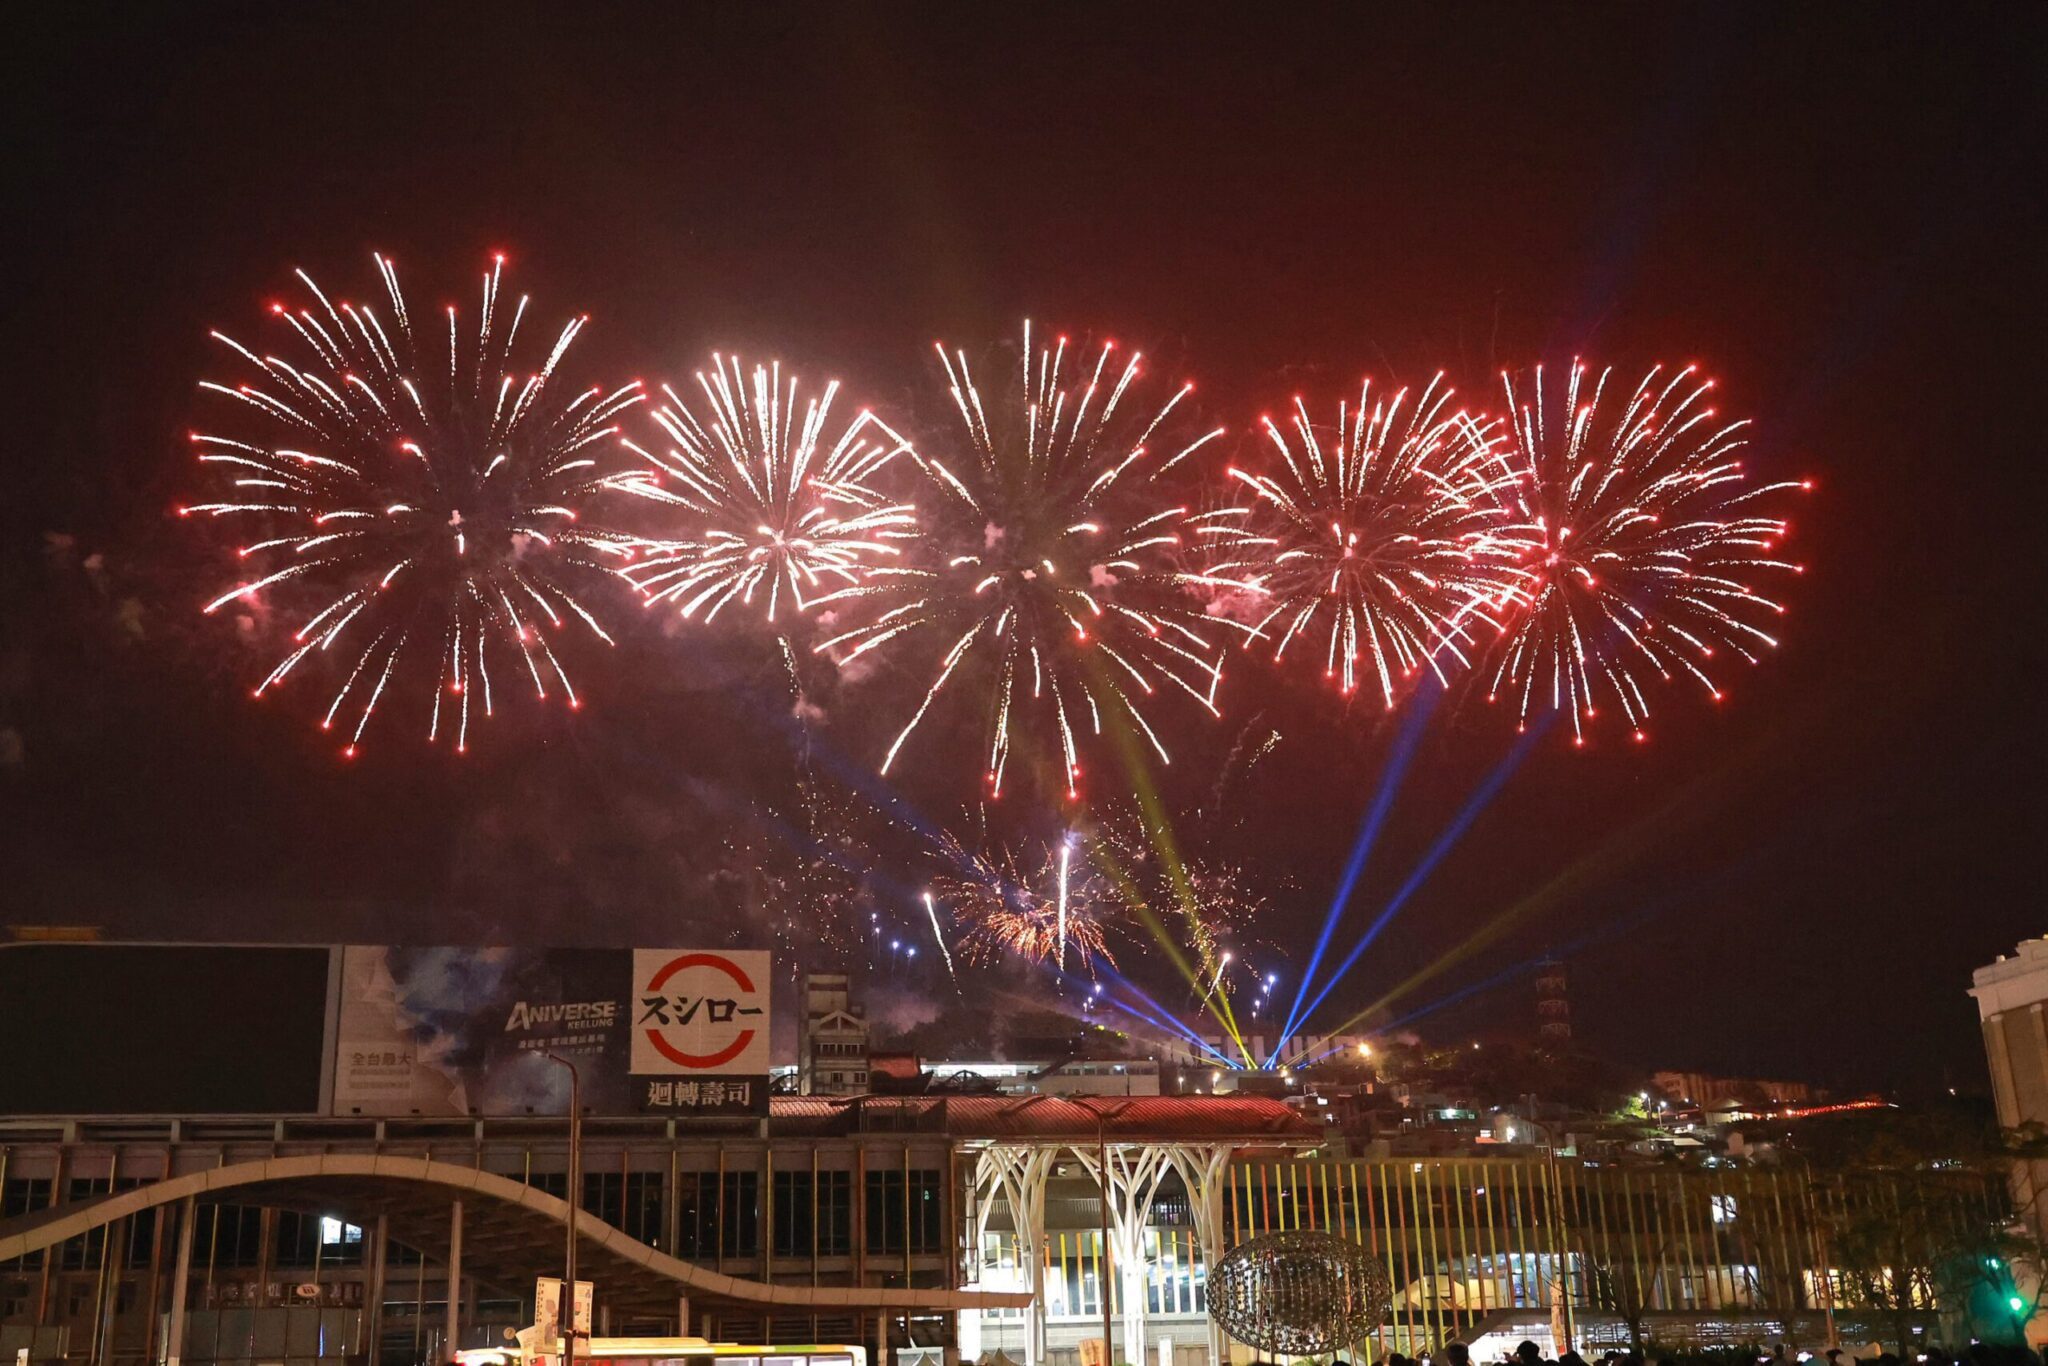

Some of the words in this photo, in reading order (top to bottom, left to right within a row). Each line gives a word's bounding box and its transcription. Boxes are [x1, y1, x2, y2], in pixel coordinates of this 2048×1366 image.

[504, 1001, 617, 1032] ANIVERSE
[638, 996, 764, 1025] スシロー
[567, 1018, 614, 1030] KEELUNG
[351, 1051, 412, 1066] 全台最大
[647, 1081, 751, 1107] 迴轉壽司
